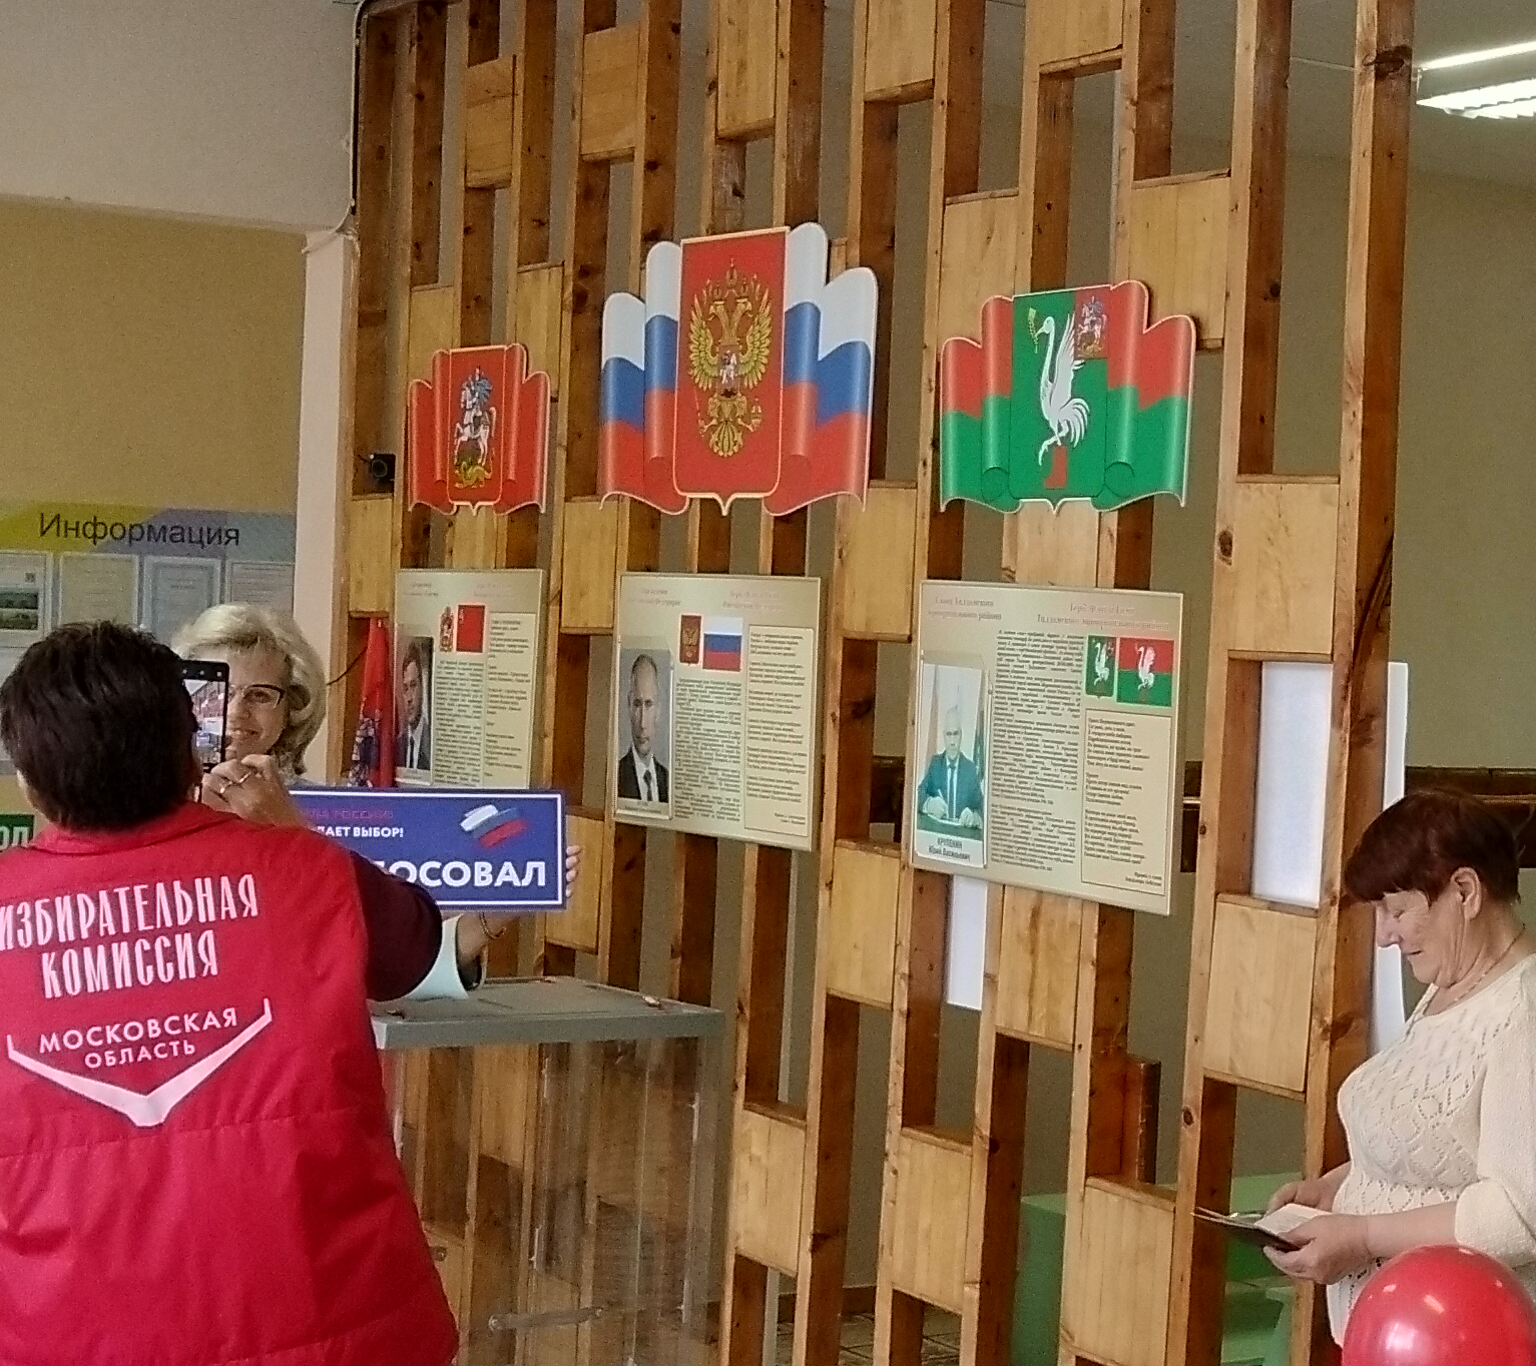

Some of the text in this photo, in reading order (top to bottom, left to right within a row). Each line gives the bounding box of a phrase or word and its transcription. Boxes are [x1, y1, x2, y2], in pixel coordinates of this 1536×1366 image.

[39, 512, 240, 549] Информация
[353, 826, 404, 838] ВЫБОР!
[373, 860, 546, 887] ОСОВАЛ
[0, 874, 258, 951] ИЗБИРАТЕЛЬНАЯ
[42, 929, 218, 999] КОМИССИЯ
[39, 1008, 238, 1054] МОСКОВСКАЯ
[85, 1039, 196, 1068] ОБЛАСТЬ
